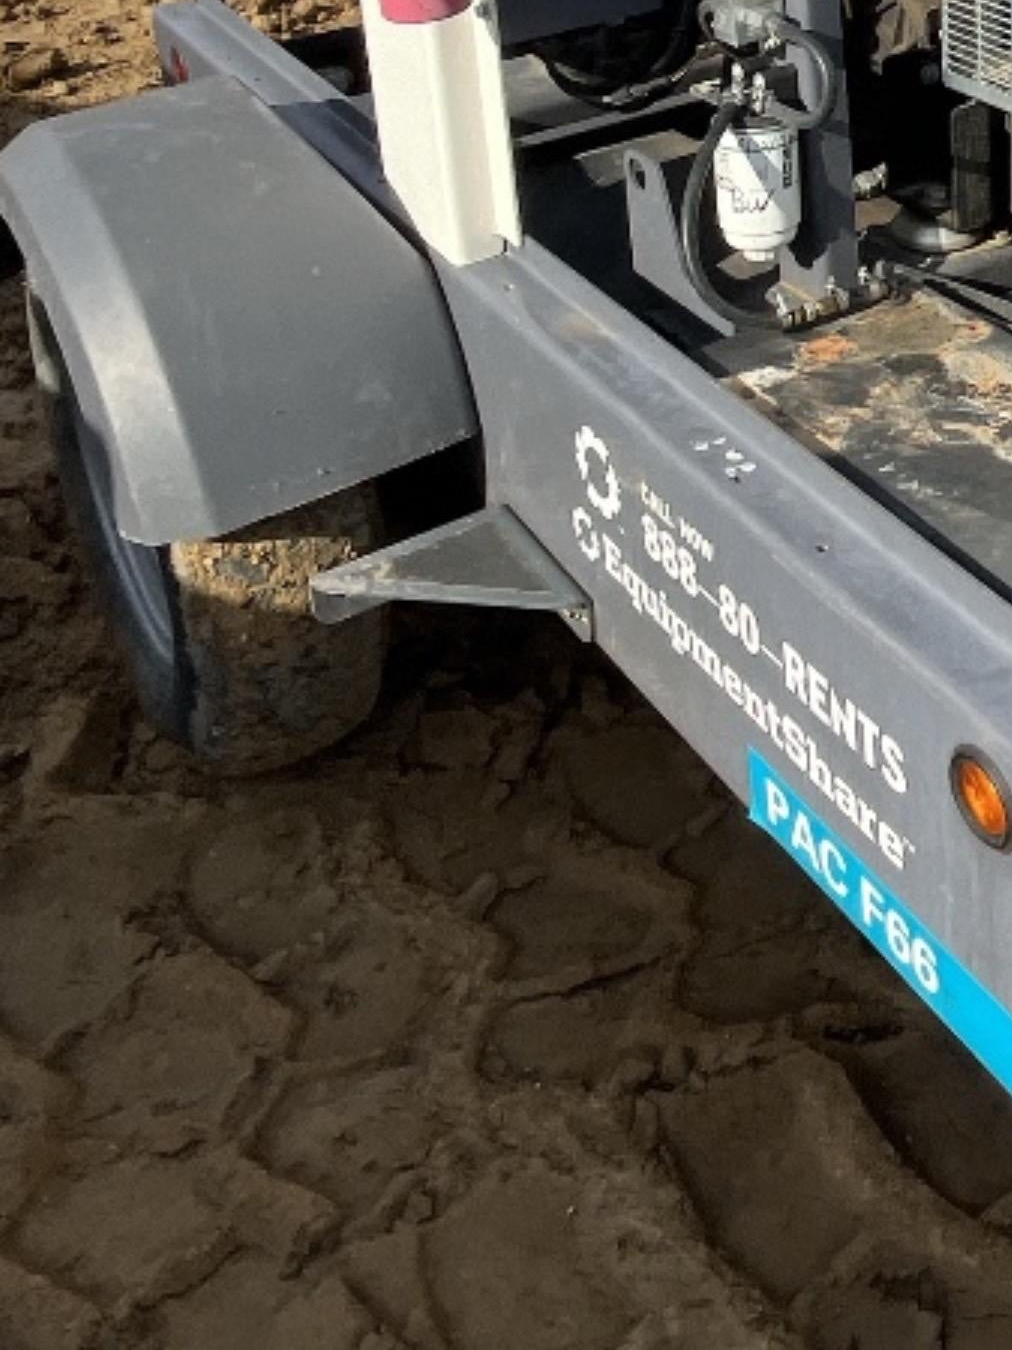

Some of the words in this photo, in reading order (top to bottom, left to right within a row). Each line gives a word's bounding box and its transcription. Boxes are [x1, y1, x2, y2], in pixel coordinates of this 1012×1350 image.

[640, 480, 675, 529] CALL
[680, 521, 714, 562] NOW
[602, 533, 906, 870] EquipmentShare
[641, 513, 907, 793] 888-80-RENTS
[765, 777, 848, 898] PAC
[859, 876, 940, 994] F66
